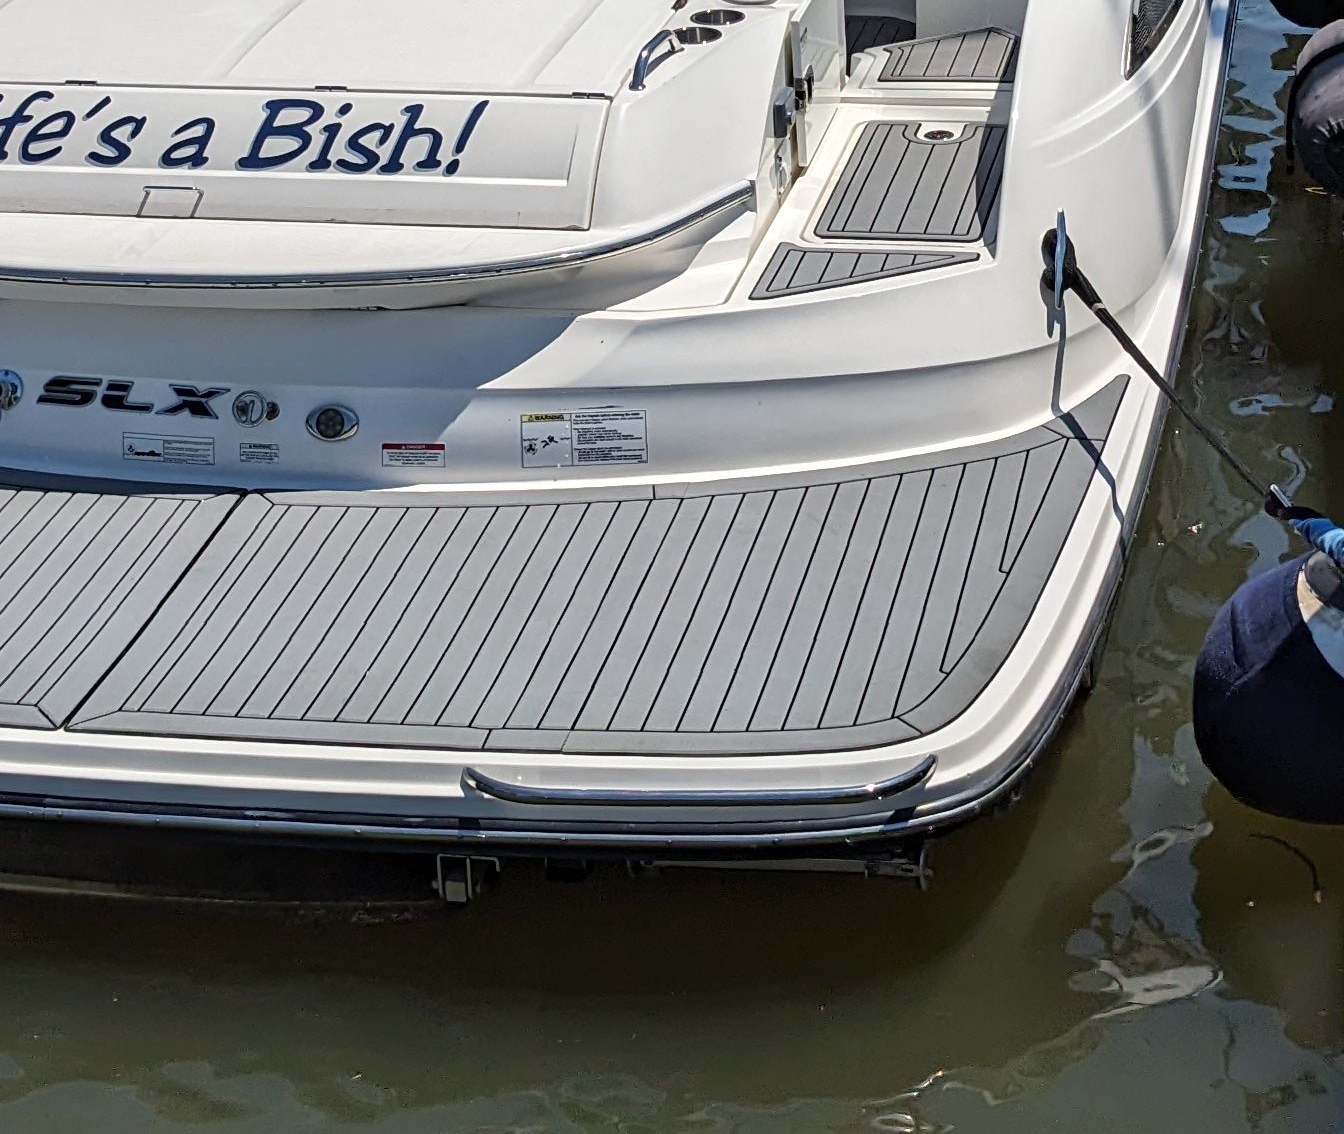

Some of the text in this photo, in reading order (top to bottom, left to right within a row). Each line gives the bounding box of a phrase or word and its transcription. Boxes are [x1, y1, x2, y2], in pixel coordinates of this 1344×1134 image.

[158, 116, 216, 170] a
[235, 98, 490, 177] Bish!
[36, 374, 232, 420] SLX
